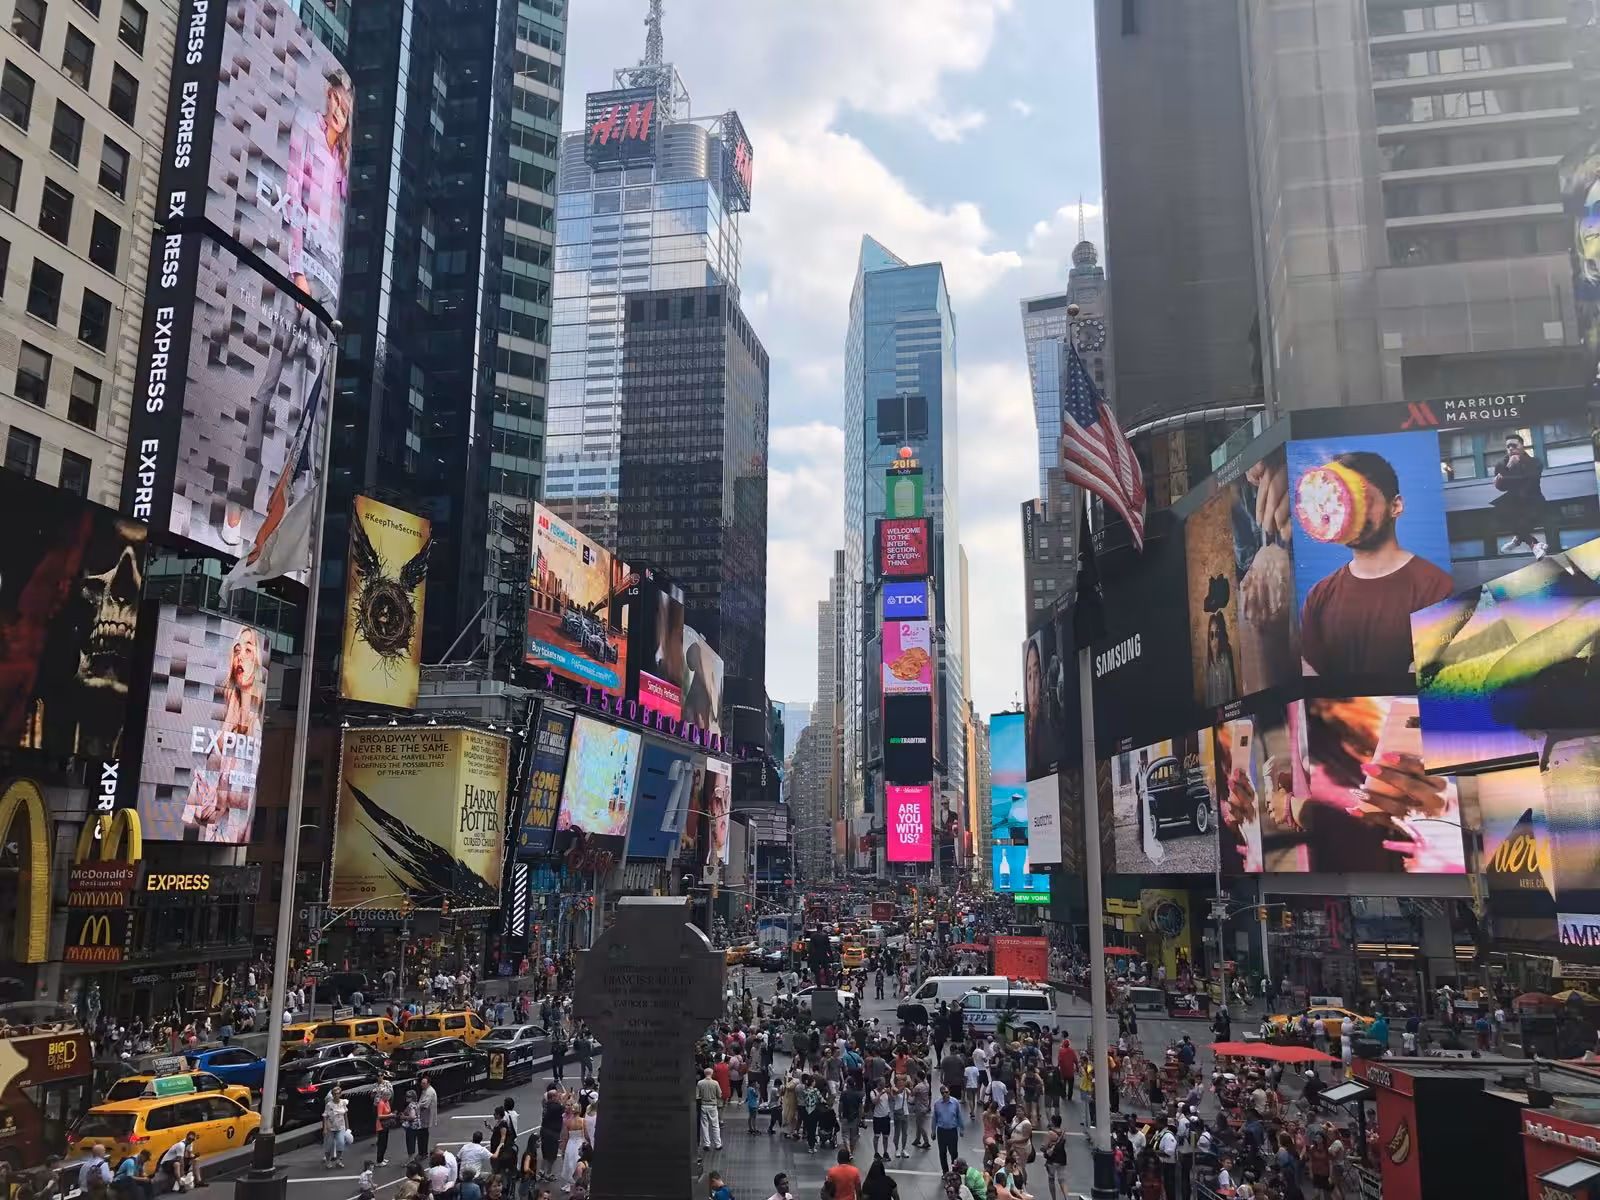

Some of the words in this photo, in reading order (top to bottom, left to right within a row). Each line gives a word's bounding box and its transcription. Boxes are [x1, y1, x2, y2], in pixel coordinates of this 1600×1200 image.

[186, 0, 209, 65] PRESS
[175, 81, 199, 169] EXPRESS
[590, 100, 655, 146] H&M
[146, 306, 174, 413] EXPRESS
[1444, 394, 1528, 410] MARRIOTT
[1445, 407, 1519, 422] MARQUIS
[133, 438, 159, 523] EXPRE
[365, 512, 423, 539] #KeepTheSecrets
[886, 527, 921, 535] WELCOME
[628, 587, 639, 596] LG
[895, 595, 924, 604] TDK
[1096, 633, 1141, 678] SAMSUNG
[585, 686, 637, 721] 1540
[643, 706, 730, 755] BROADWAY
[420, 733, 445, 743] WILL
[350, 744, 382, 754] NEVER
[384, 744, 398, 753] BE
[399, 743, 419, 753] THE
[422, 743, 452, 753] SAME.
[532, 770, 560, 792] COME
[463, 784, 501, 812] HARRY
[898, 803, 921, 814] ARE
[459, 806, 501, 833] POTTER
[525, 807, 556, 828] AWAY
[898, 813, 921, 824] YOU
[896, 823, 924, 834] WITH
[899, 833, 919, 844] US?
[71, 869, 134, 881] McDonald's
[147, 873, 211, 892] EXPRESS
[48, 1041, 65, 1055] BIG
[47, 1053, 65, 1066] BUS
